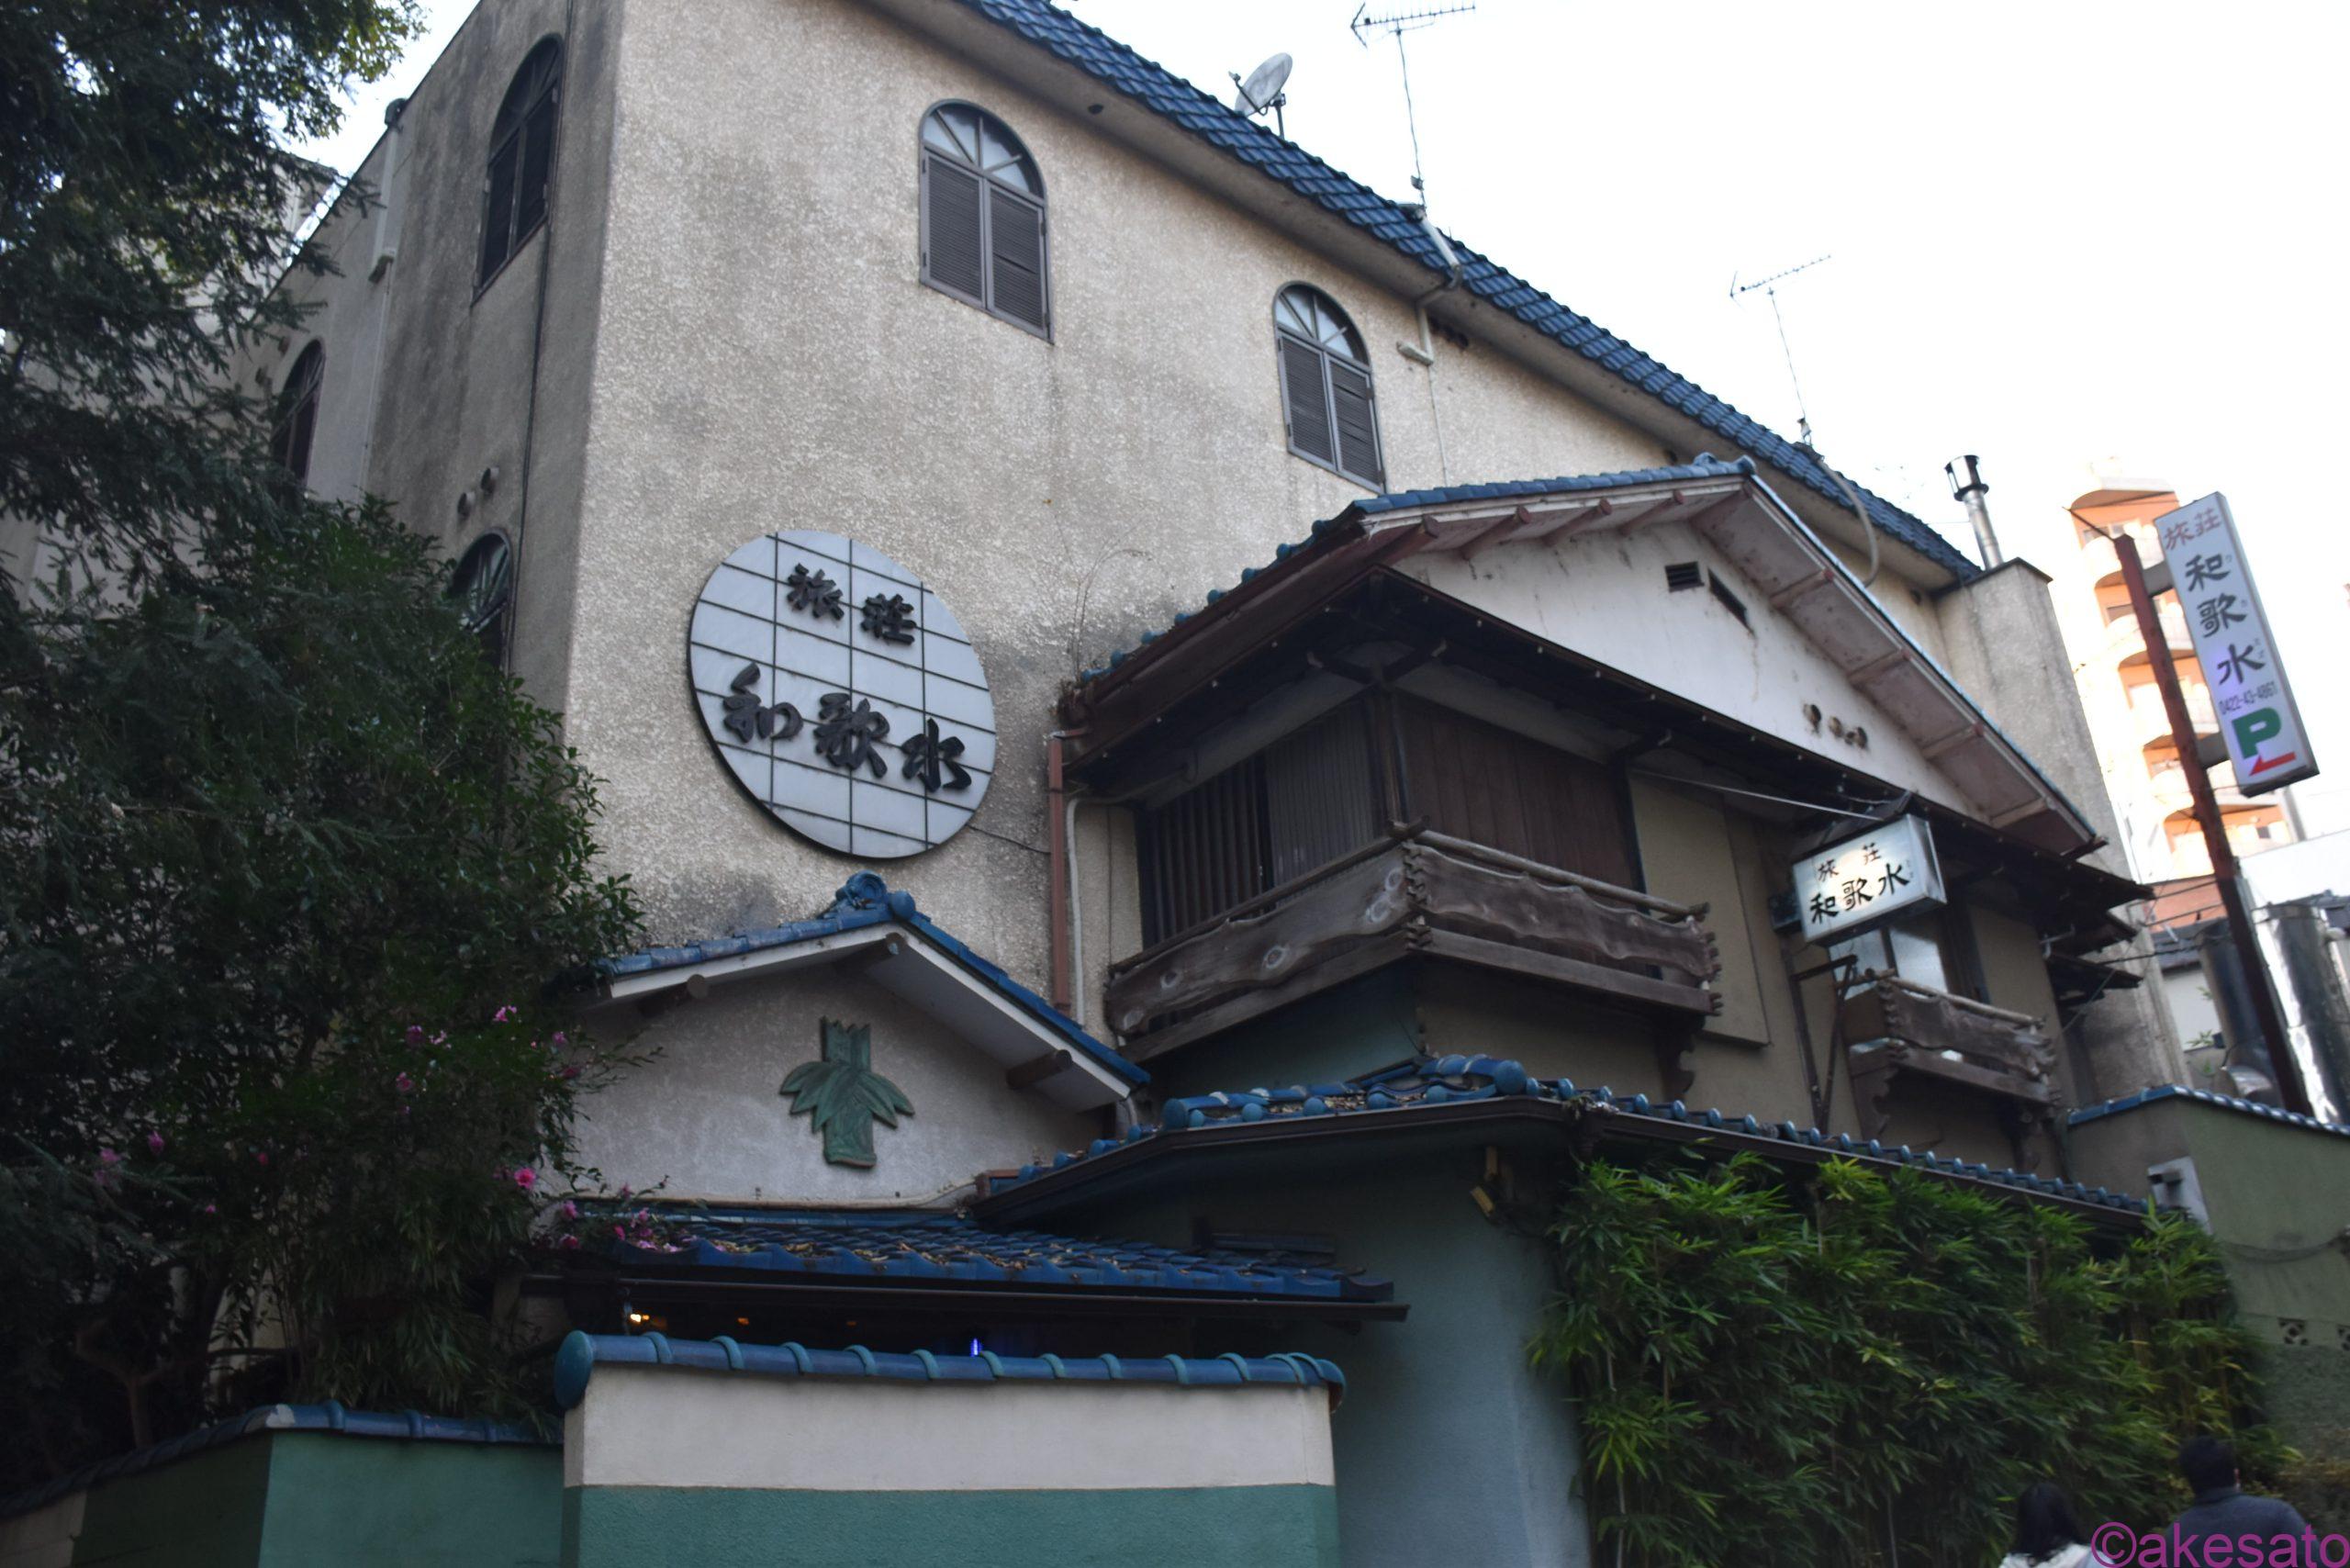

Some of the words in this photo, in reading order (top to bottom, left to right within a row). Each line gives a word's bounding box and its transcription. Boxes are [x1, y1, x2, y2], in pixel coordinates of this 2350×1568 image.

[2165, 508, 2221, 550] 旅荘
[2185, 553, 2266, 686] 和歌水
[722, 661, 972, 793] 和歌水
[2231, 707, 2282, 759] P
[1818, 842, 1882, 883] 旅荘
[1809, 862, 1910, 924] 和歌水
